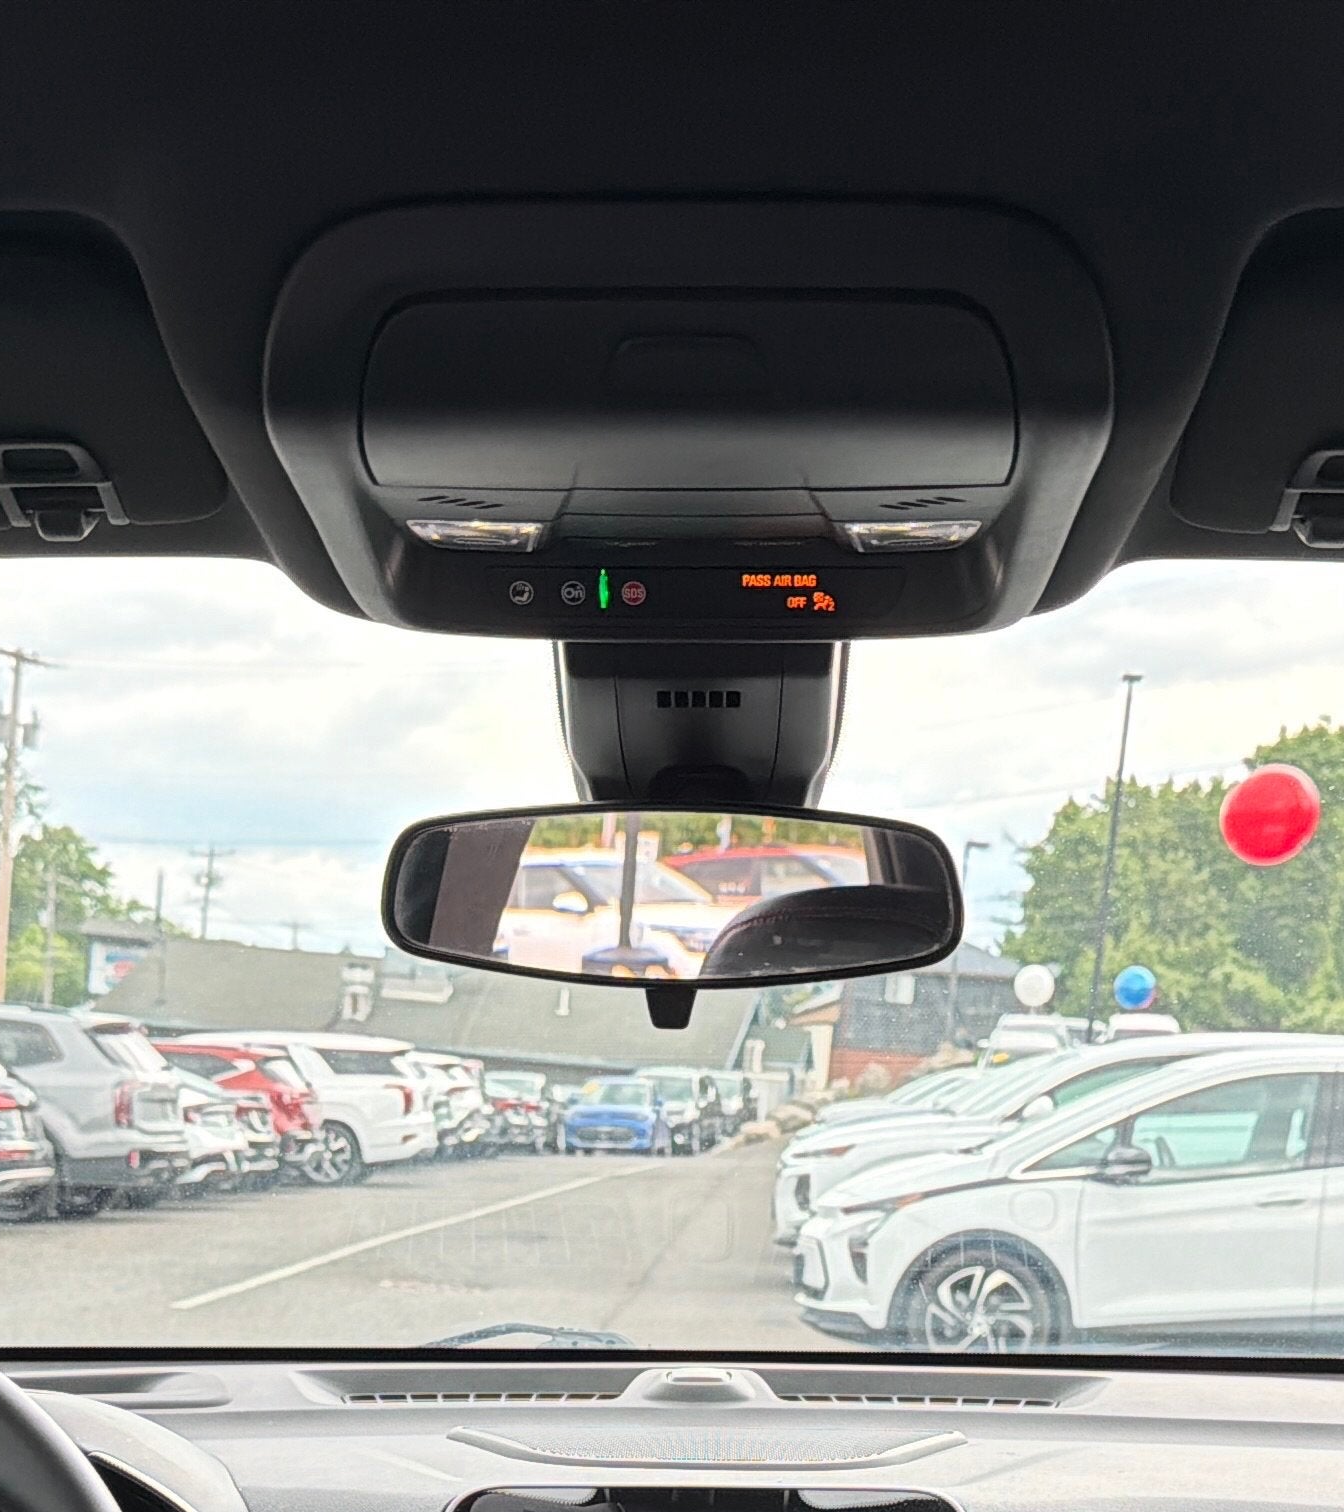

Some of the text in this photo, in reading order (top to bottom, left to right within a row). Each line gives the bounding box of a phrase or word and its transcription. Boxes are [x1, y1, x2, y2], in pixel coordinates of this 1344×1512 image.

[742, 574, 817, 588] PASS AIR BAG
[623, 587, 645, 600] SOS
[787, 596, 807, 609] OFF
